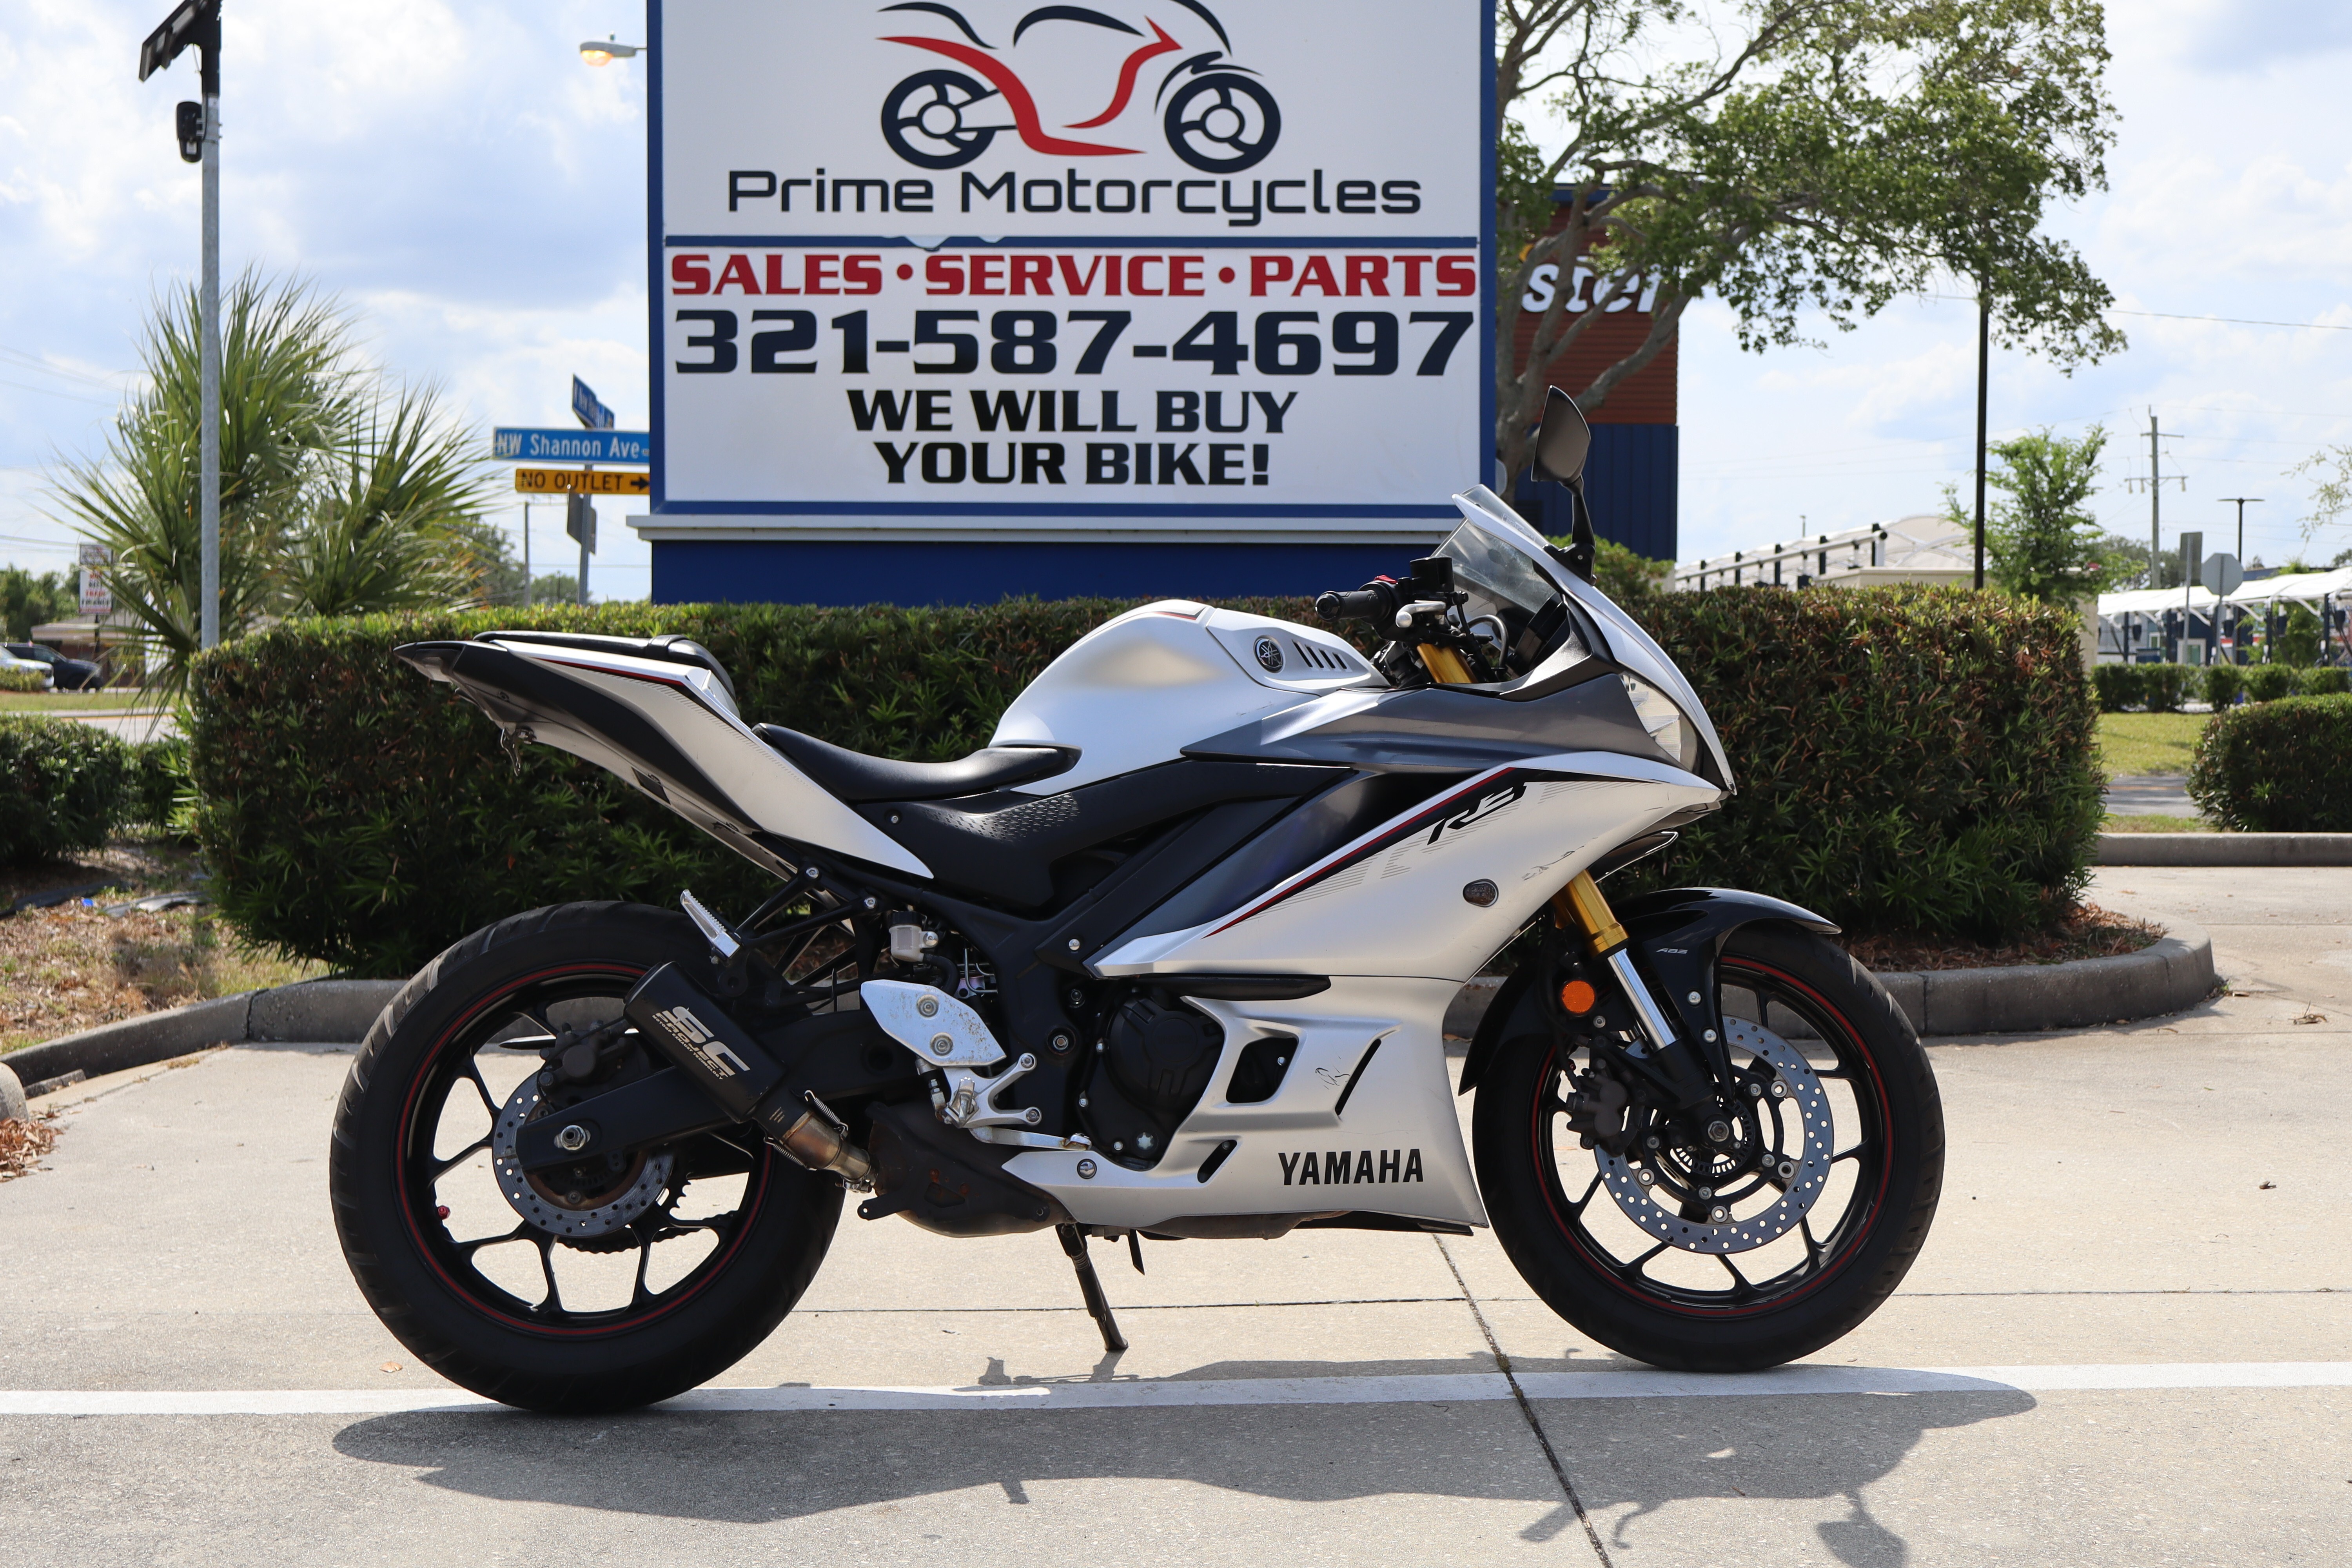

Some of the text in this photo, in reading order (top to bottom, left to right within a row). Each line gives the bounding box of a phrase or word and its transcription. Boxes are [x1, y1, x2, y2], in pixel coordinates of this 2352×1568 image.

[730, 169, 1421, 227] Prime Motorcycles
[672, 255, 1475, 296] SALES SERVICE PARTS
[676, 310, 1474, 376] 321-587-4697
[847, 390, 1298, 433] WE WILL BUY
[497, 433, 640, 459] NW Shannon Ave
[873, 442, 1269, 486] YOUR BIKE!
[521, 471, 623, 491] NO OUTLET
[655, 1013, 728, 1077] PROJECT
[693, 1052, 723, 1080] TECHNOLOGY
[1278, 1149, 1424, 1186] YAMAHA
